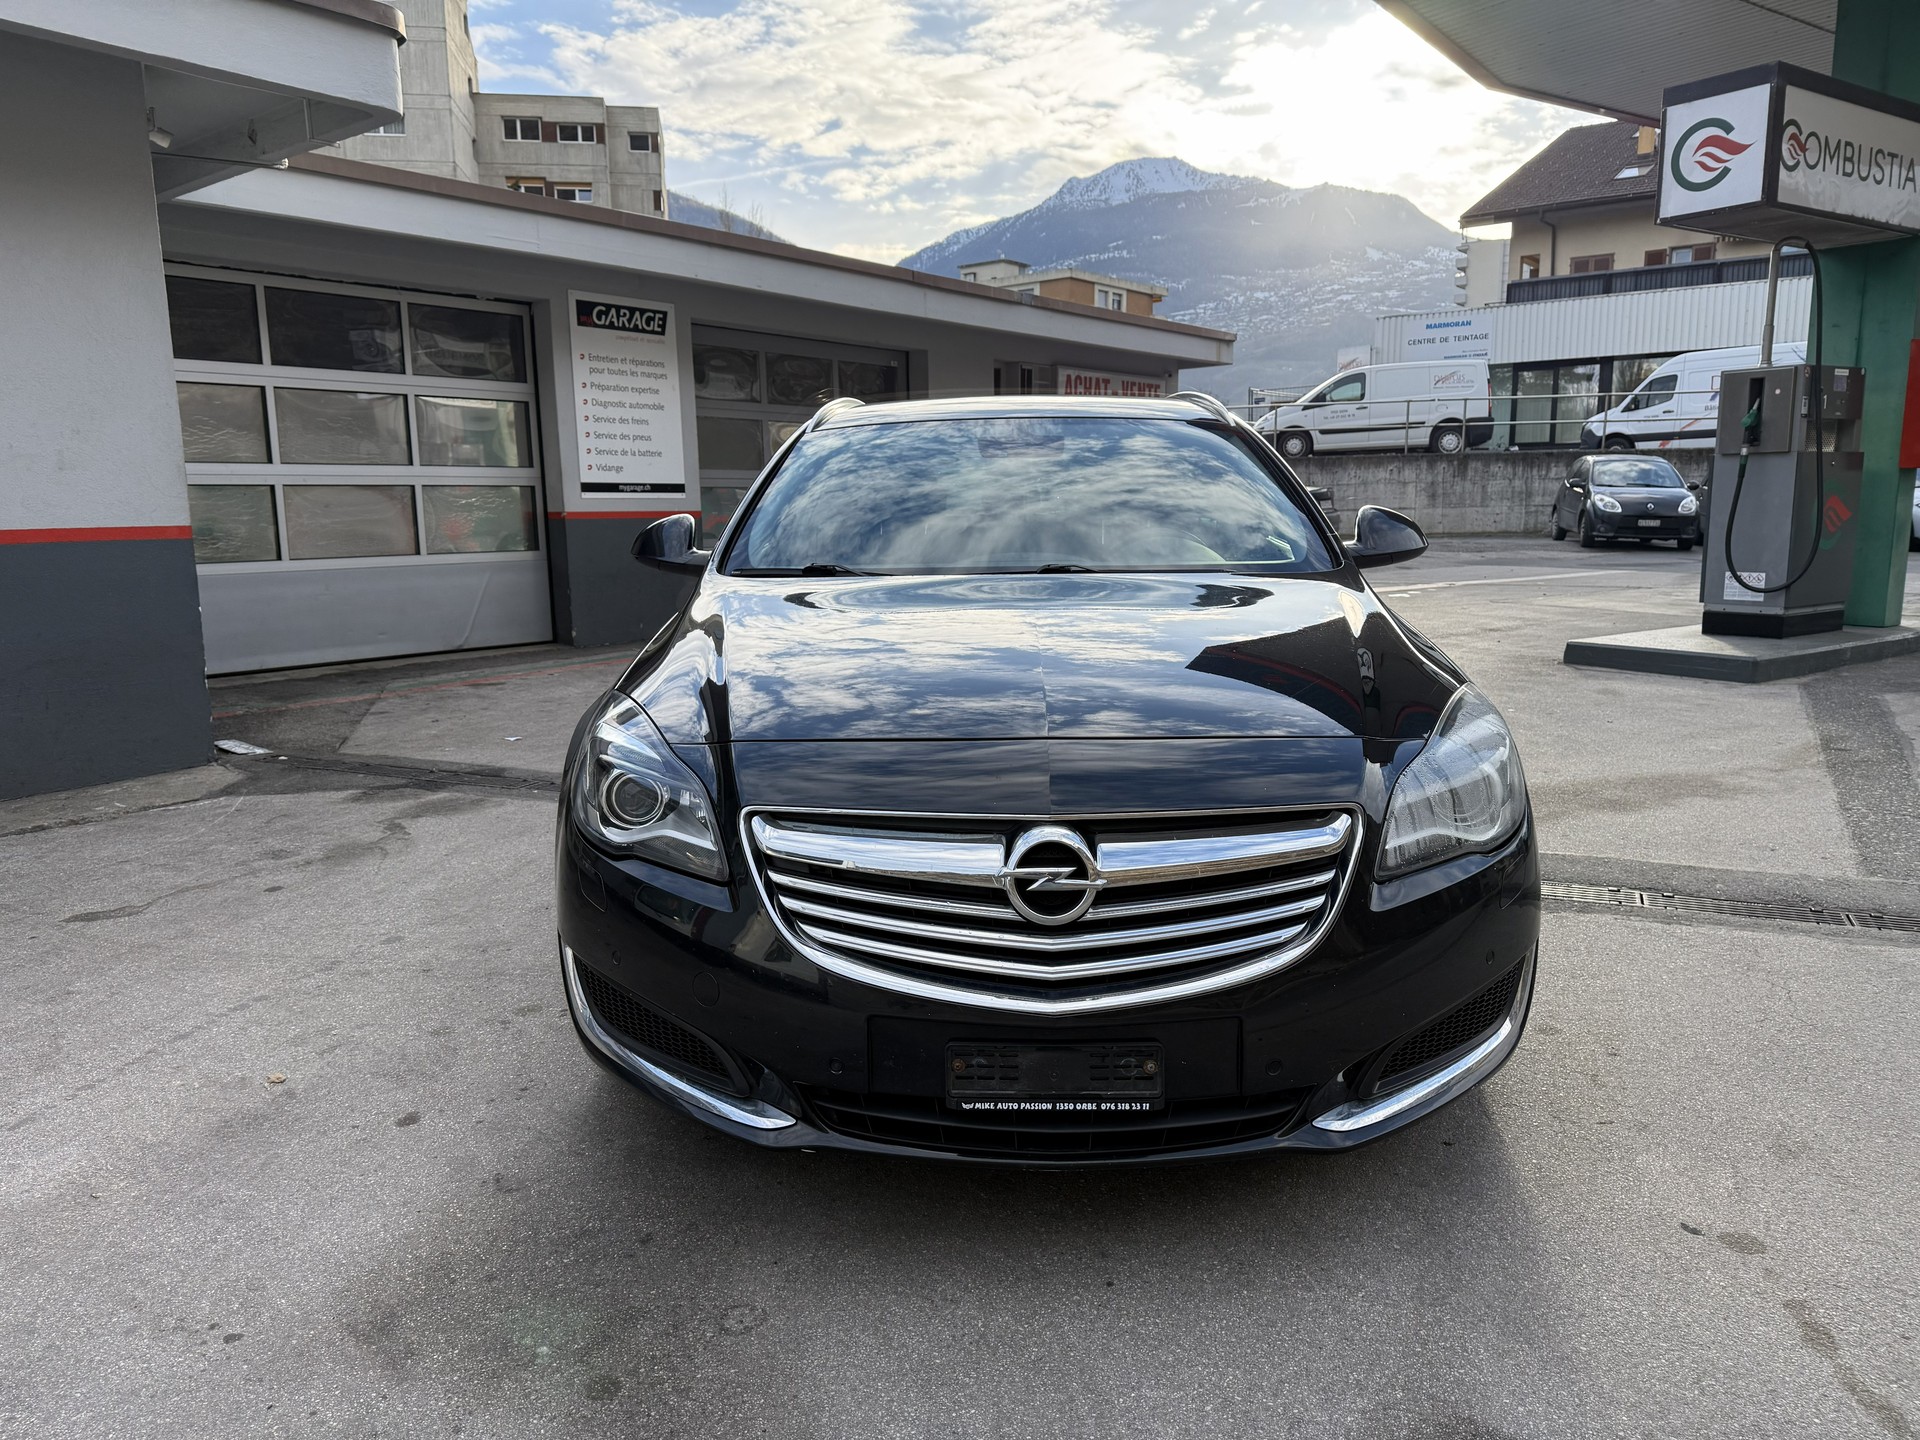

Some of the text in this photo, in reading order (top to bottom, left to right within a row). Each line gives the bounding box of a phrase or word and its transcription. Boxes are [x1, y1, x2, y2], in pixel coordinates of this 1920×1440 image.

[1425, 320, 1472, 329] MARMORAN
[1407, 337, 1437, 346] CENTRE
[1453, 333, 1490, 342] TEINTAGE
[588, 353, 665, 368] Entretien et réparations
[589, 367, 668, 381] pour toutes les marques
[590, 382, 660, 396] Préparation expertise
[1064, 374, 1111, 396] ACHAT
[1121, 380, 1161, 398] VENTE
[591, 398, 665, 411] Diagnostic automobile
[592, 414, 649, 426] Service des freins
[593, 431, 652, 443] Service des pneus
[594, 447, 663, 458] Service de la batterie
[595, 464, 624, 474] Vidange
[618, 484, 651, 492] mygarage.ch
[974, 1102, 1150, 1110] MIKE AUTO PASSION 1350 ORBE 076 318 23 11
